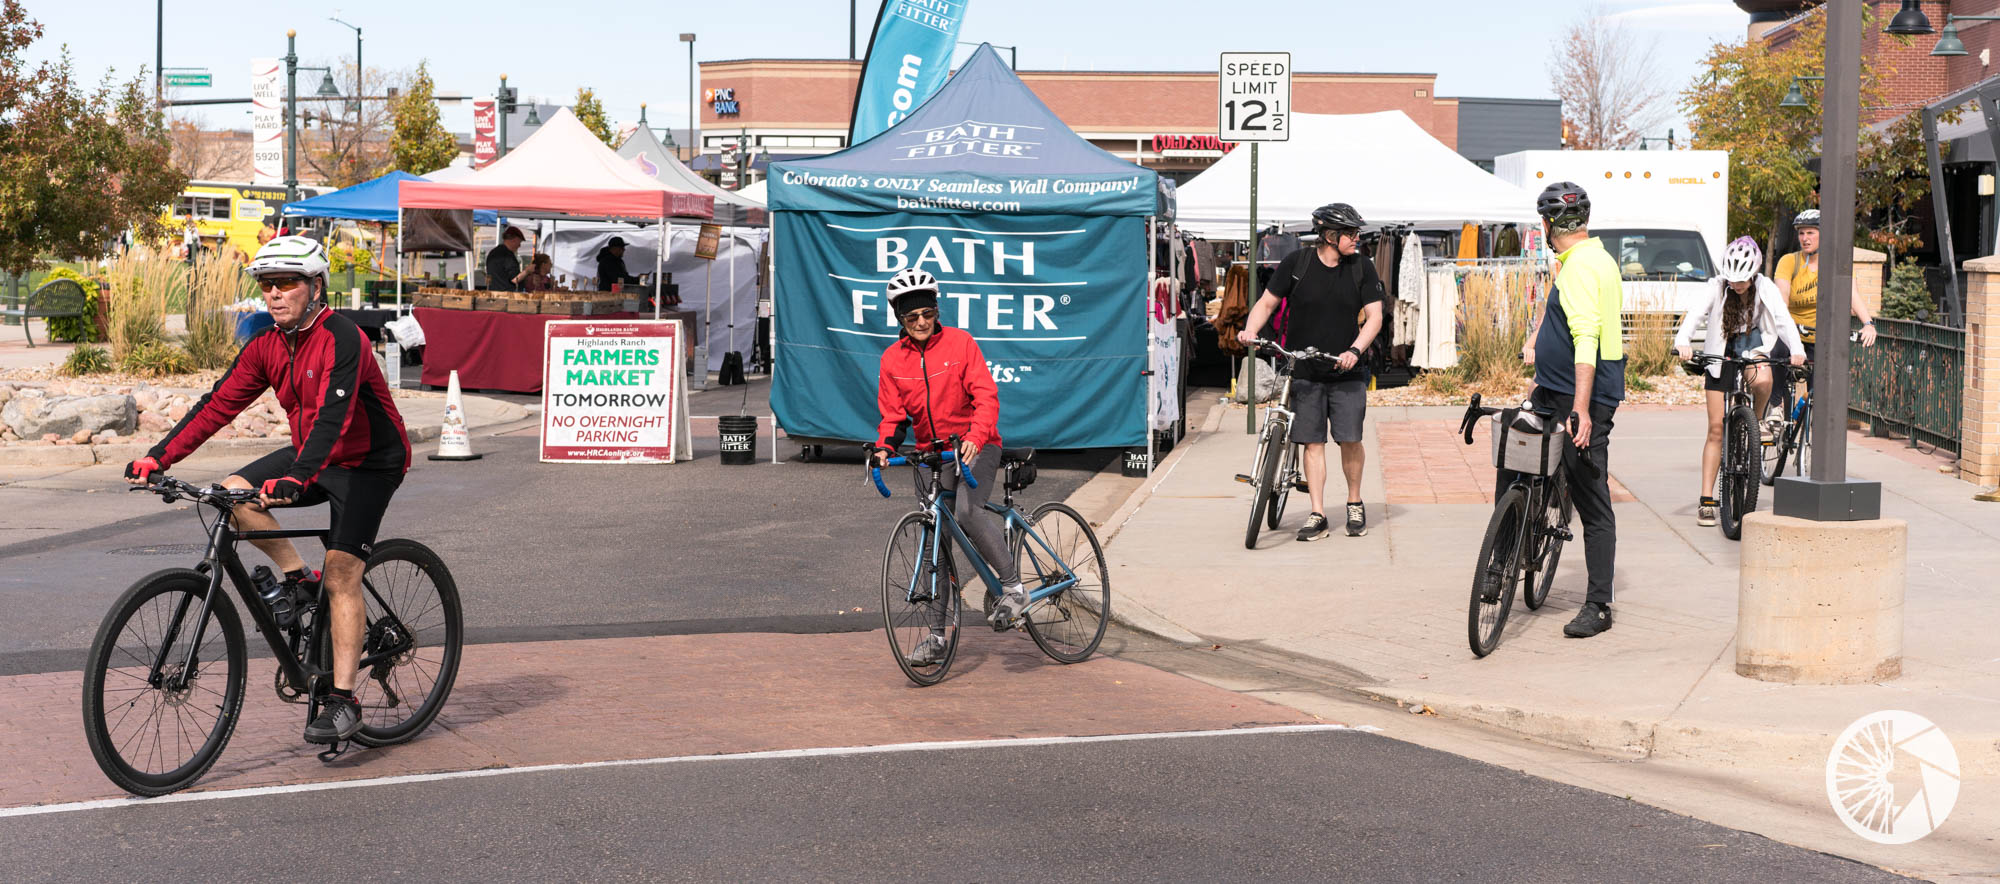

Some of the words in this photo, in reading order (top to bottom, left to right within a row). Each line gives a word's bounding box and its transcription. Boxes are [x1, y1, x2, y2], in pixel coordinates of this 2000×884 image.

[911, 0, 949, 14] ATH
[1227, 63, 1285, 76] SPEED
[714, 88, 733, 101] PNC
[1232, 82, 1277, 94] LIMIT
[715, 101, 738, 114] BANK
[1225, 100, 1267, 131] 12
[925, 123, 1015, 143] BATH
[1152, 135, 1188, 153] COLD
[256, 152, 280, 161] 5920
[874, 177, 925, 191] ONLY
[928, 179, 1004, 194] Seamless
[1009, 179, 1048, 194] Wall
[1052, 176, 1139, 195] Company!
[897, 195, 1021, 212] bathfitter.com
[876, 236, 1035, 276] BATH
[852, 289, 1071, 331] FITER®
[577, 338, 618, 347] Highlands
[620, 338, 646, 346] Ranch
[563, 349, 660, 366] FARMERS
[566, 369, 655, 386] MARKET
[552, 394, 666, 407] TOMORROW
[552, 415, 575, 427] NO
[580, 415, 665, 428] OVERNIGHT
[576, 430, 639, 442] PARKING
